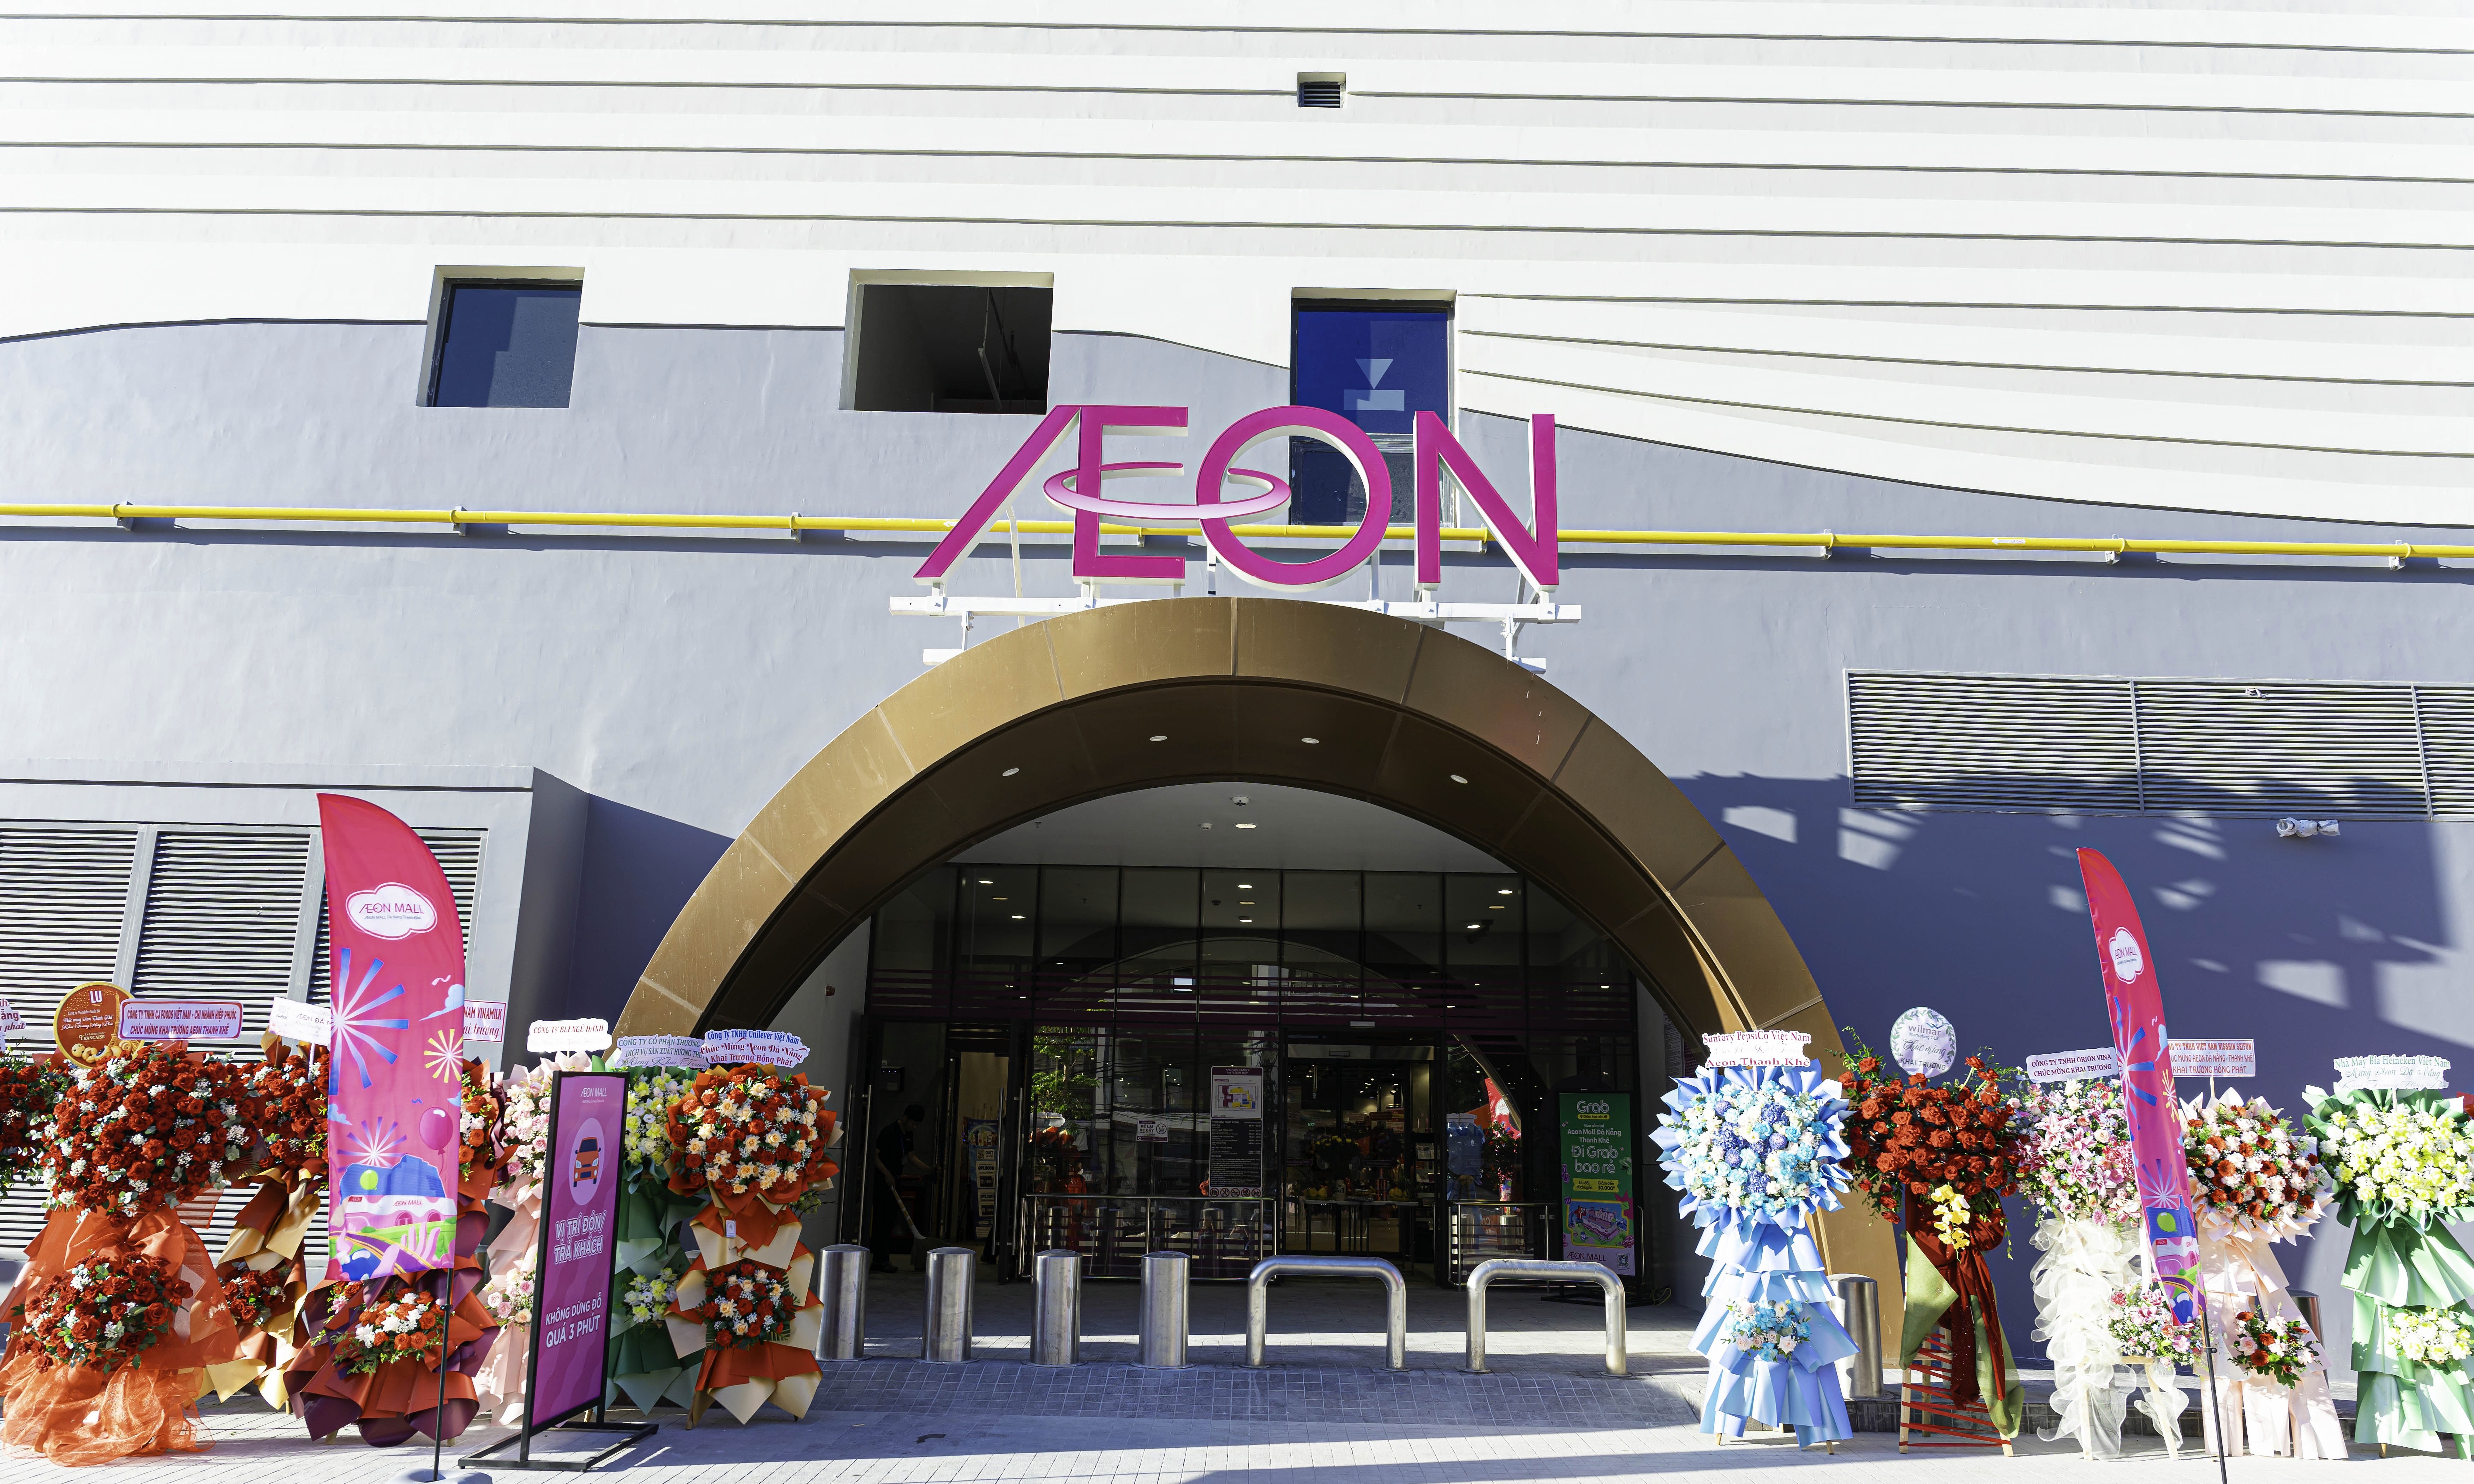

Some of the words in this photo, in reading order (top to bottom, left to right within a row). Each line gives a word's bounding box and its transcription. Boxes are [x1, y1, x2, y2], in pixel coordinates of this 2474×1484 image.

[395, 903, 424, 914] MALL
[90, 990, 102, 1003] LU
[0, 1009, 19, 1021] ẵng
[127, 1007, 137, 1020] CÔNG
[138, 1010, 143, 1020] TY
[144, 1010, 155, 1020] TNHH
[155, 1010, 160, 1020] CJ
[161, 1010, 173, 1020] FOODS
[174, 1007, 182, 1022] VIỆT
[183, 1010, 191, 1020] NAM
[202, 1008, 214, 1020] NHÁNH
[215, 1008, 223, 1022] HIỆP
[478, 1008, 502, 1020] VINAMILK
[130, 1022, 143, 1035] CHÚC
[144, 1022, 158, 1035] MỪNG
[159, 1026, 169, 1035] KHAI
[189, 1026, 202, 1035] AEON
[203, 1026, 219, 1035] THANH
[219, 1023, 229, 1035] KHÊ
[534, 1025, 549, 1034] CÔNG
[1908, 1025, 1941, 1035] wilmar
[619, 1038, 637, 1046] CÔNG
[677, 1038, 700, 1047] THƯƠNG
[707, 1031, 722, 1040] Công
[724, 1031, 730, 1040] Ty
[749, 1031, 773, 1040] Unilever
[774, 1032, 785, 1043] Việt
[787, 1035, 799, 1045] Nam
[1703, 1034, 1734, 1044] Suntory
[1737, 1030, 1768, 1043] PepsiCo
[1771, 1031, 1788, 1043] Việt
[1791, 1032, 1810, 1041] Nam
[700, 1044, 719, 1055] Chúc
[769, 1045, 779, 1053] Đà
[1903, 1039, 1924, 1051] Chúc
[2197, 1041, 2206, 1052] VIỆT
[626, 1049, 638, 1058] DỊCH
[757, 1053, 774, 1063] Hồng
[776, 1057, 793, 1066] Phát
[2178, 1052, 2191, 1062] MỪNG
[2206, 1052, 2212, 1062] ĐÀ
[2245, 1053, 2253, 1062] KHÊ
[1785, 1058, 1810, 1066] Khê
[1918, 1061, 1946, 1070] TRƯƠNG
[2335, 1059, 2349, 1068] Nhà
[2352, 1057, 2367, 1068] Máy
[2370, 1056, 2380, 1065] Bia
[2382, 1055, 2416, 1065] Heineken
[2418, 1056, 2432, 1068] Việt
[2434, 1057, 2450, 1068] Nam
[2034, 1068, 2050, 1077] CHÚC
[2051, 1067, 2070, 1075] MỪNG
[2189, 1065, 2212, 1073] TRƯƠNG
[2214, 1063, 2230, 1073] HỒNG
[2232, 1064, 2247, 1073] PHÁT
[594, 1088, 607, 1097] MALL
[1577, 1100, 1609, 1113] Grab
[1606, 1128, 1621, 1137] Nẵng
[1571, 1145, 1584, 1157] Đi
[1587, 1145, 1618, 1159] Grab
[1574, 1161, 1600, 1173] bao
[1602, 1159, 1616, 1174] rẻ
[555, 1220, 566, 1244] VỊ
[567, 1212, 582, 1238] TRÍ
[582, 1210, 607, 1234] ĐÓN/
[554, 1237, 572, 1265] TRẢ
[573, 1233, 603, 1260] KHÁCH
[1587, 1254, 1607, 1262] MALL
[545, 1307, 570, 1326] KHÔNG
[572, 1300, 590, 1317] DỪNG
[592, 1292, 602, 1310] ĐỖ
[546, 1322, 566, 1348] QUÁ
[569, 1323, 575, 1340] 3
[576, 1312, 600, 1337] PHÚT
